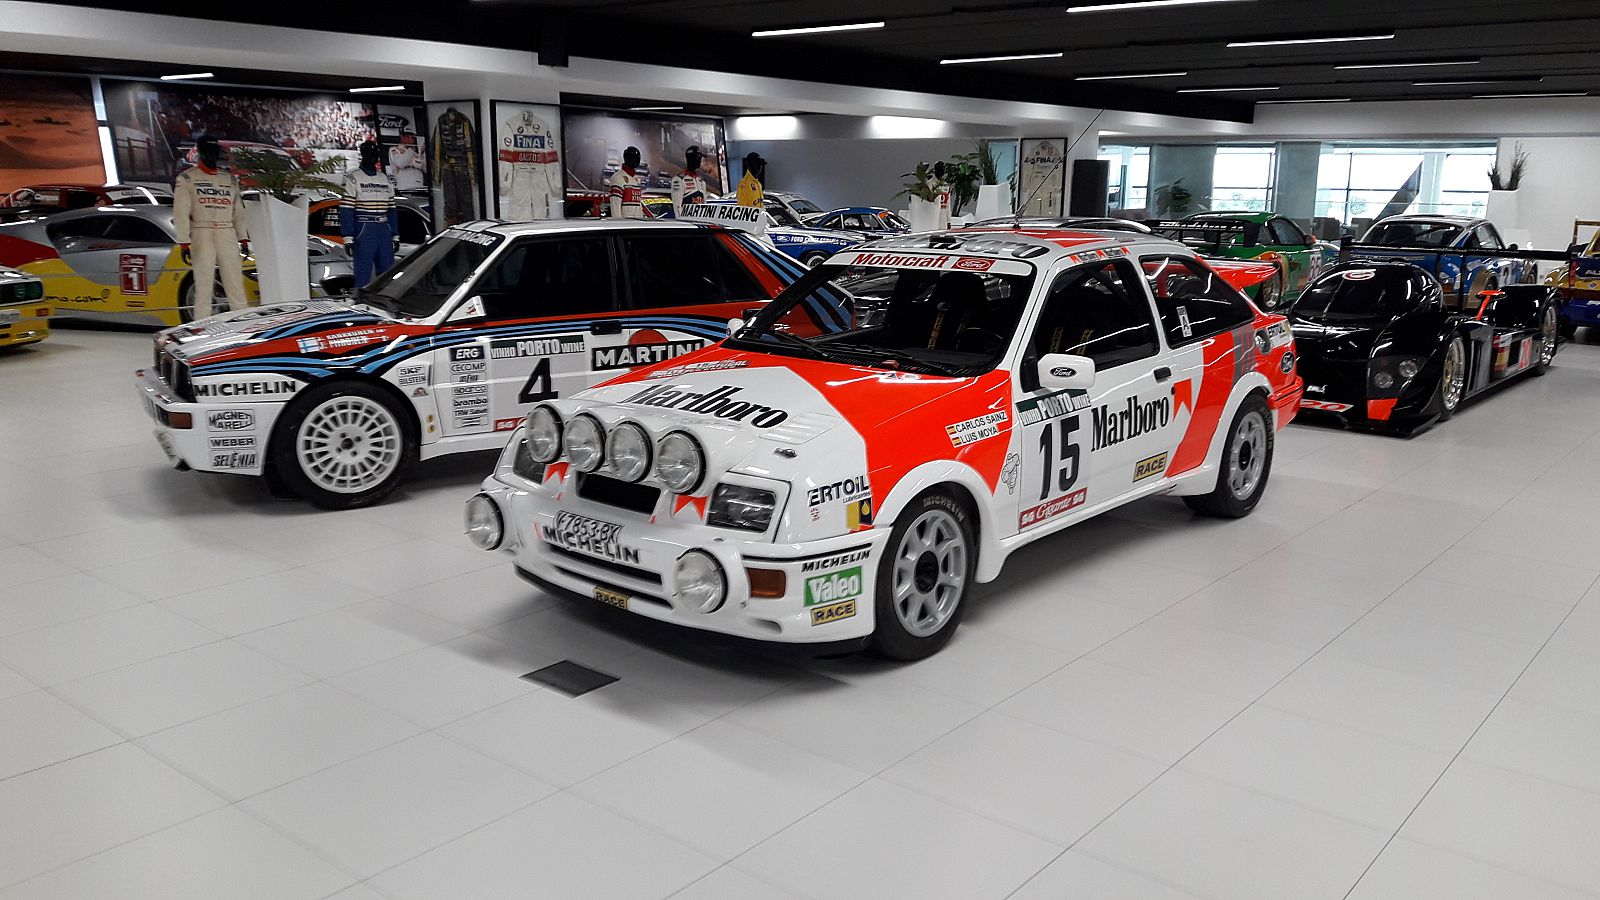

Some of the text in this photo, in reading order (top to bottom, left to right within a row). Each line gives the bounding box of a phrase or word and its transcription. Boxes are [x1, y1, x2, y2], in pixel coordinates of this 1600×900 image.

[379, 117, 403, 128] Ford
[517, 135, 541, 148] FINA
[196, 188, 231, 196] NOKIA
[681, 203, 760, 223] MARTINI RACING
[851, 253, 950, 268] Motorcraft
[128, 267, 139, 291] 1
[456, 348, 479, 360] ERG
[491, 339, 585, 359] VINHO PORTO WINE
[400, 366, 422, 376] SKF
[451, 363, 485, 372] CECOMP
[1052, 366, 1073, 376] Ford
[193, 381, 296, 397] MICHELIN
[518, 357, 559, 404] 4
[619, 384, 788, 428] Marlboro
[1036, 392, 1074, 419] PORTO
[955, 411, 1007, 433] CARLOS SAINZ
[1091, 395, 1170, 452] Marlboro
[210, 437, 254, 447] WEBER
[960, 426, 998, 444] LUIS MOYA
[1039, 414, 1080, 501] 15
[1136, 459, 1166, 478] RACE
[542, 525, 639, 563] MICHELIN
[801, 550, 871, 573] MICHELIN
[810, 574, 861, 604] Valeo
[813, 602, 855, 621] RACE
